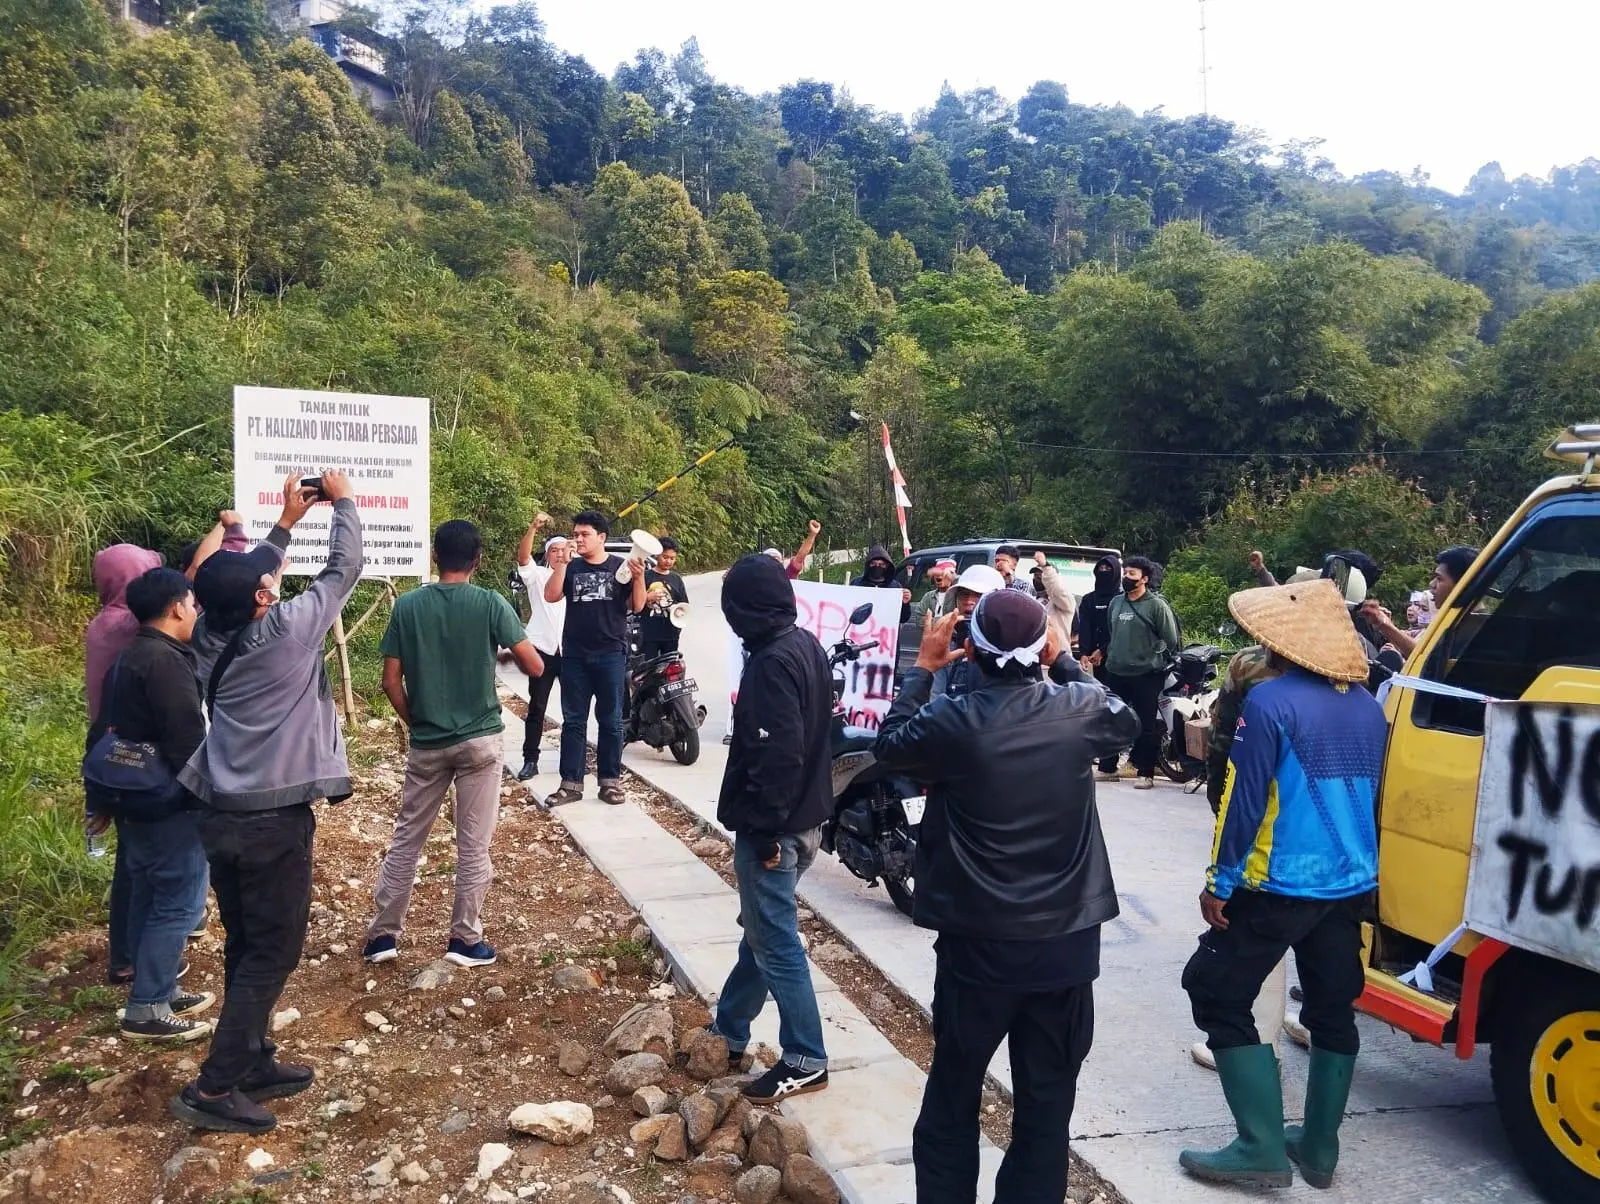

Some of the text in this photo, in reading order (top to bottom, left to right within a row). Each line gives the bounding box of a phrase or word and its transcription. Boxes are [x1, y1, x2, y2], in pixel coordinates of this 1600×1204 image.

[299, 400, 370, 417] TANAH MILIK
[247, 416, 418, 446] PT. HALIZANO WISTARA PERSADA
[254, 451, 413, 468] DIBAWAH PERLINDUNGAN KANTOR HUKUM
[366, 469, 394, 479] REKAN
[258, 491, 409, 510] DILA TANPA IZIN
[394, 539, 413, 549] tanah
[311, 555, 329, 565] PASA
[382, 556, 396, 566] 389
